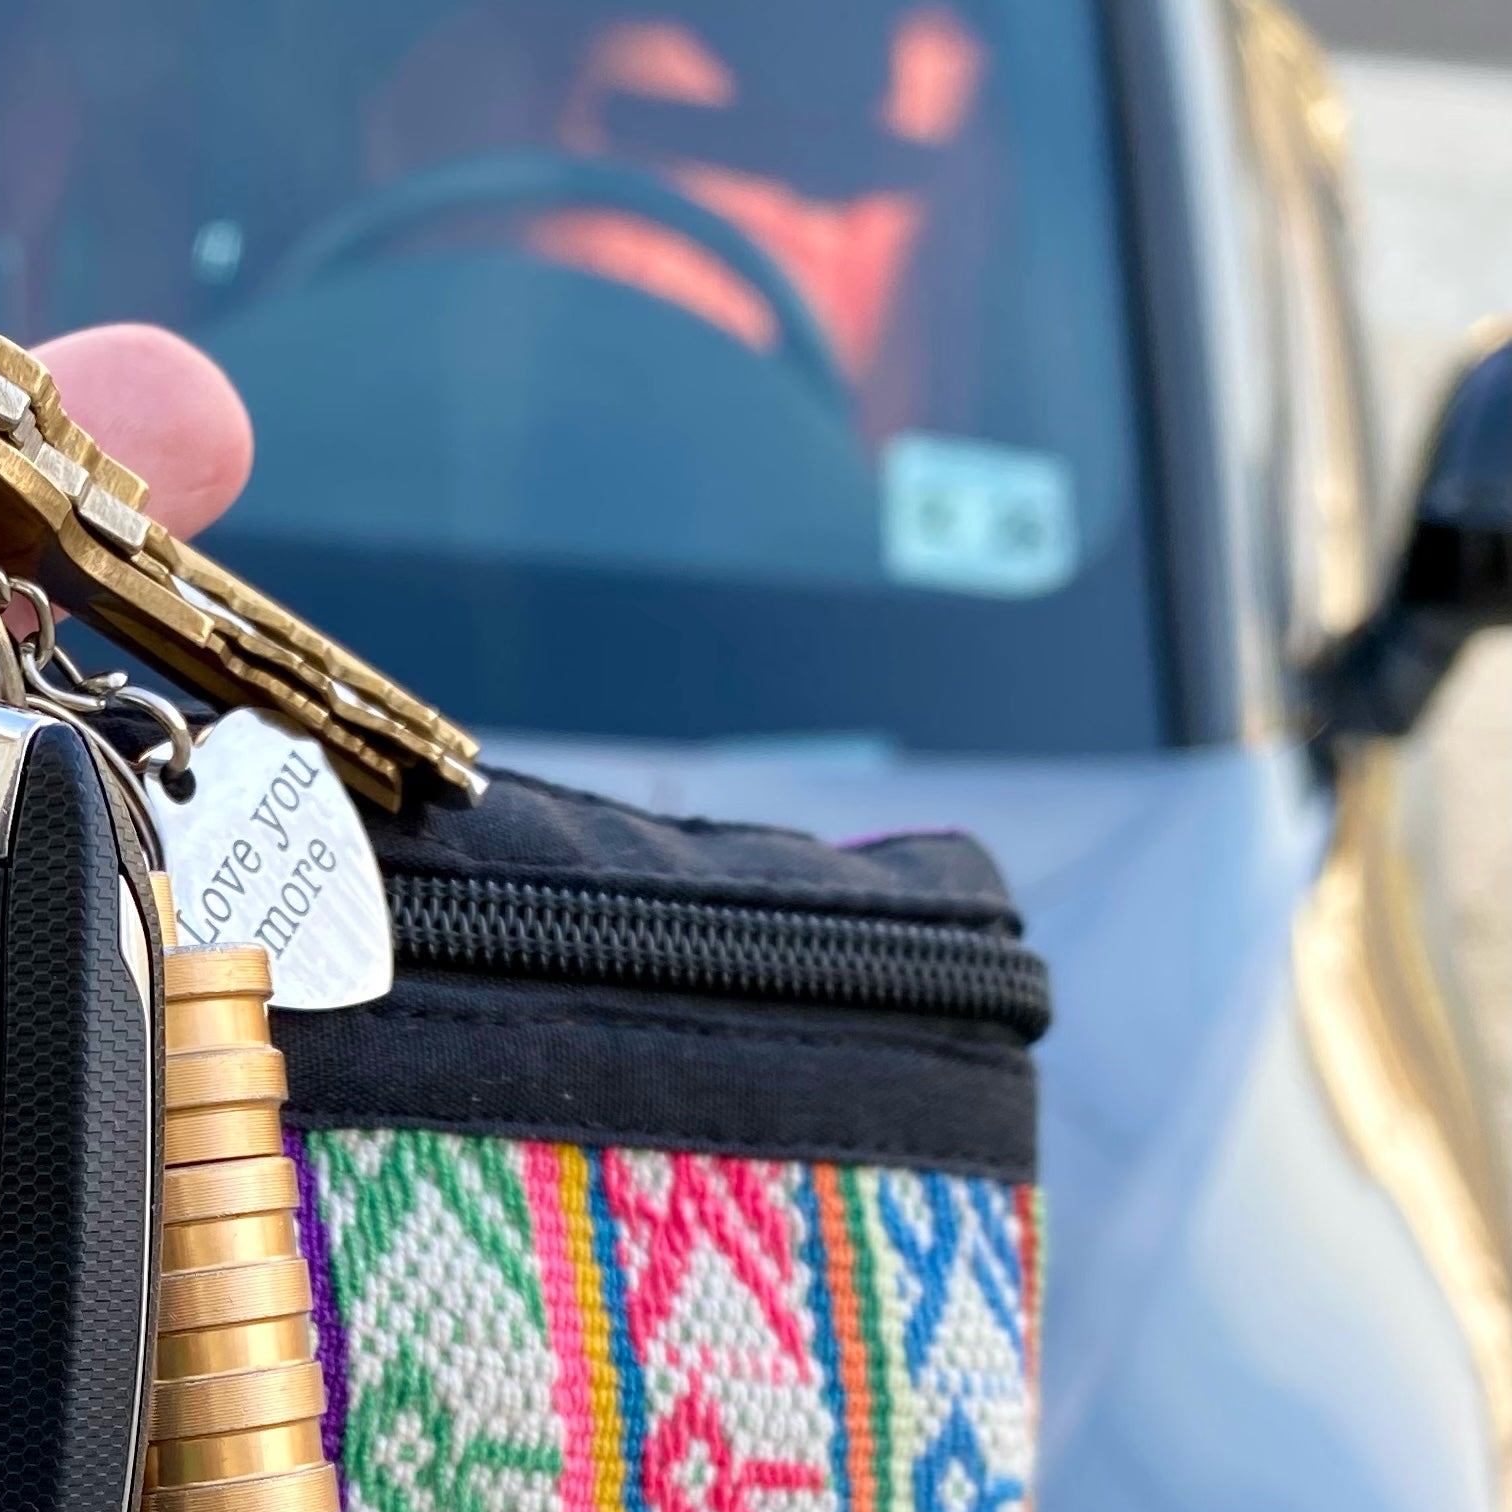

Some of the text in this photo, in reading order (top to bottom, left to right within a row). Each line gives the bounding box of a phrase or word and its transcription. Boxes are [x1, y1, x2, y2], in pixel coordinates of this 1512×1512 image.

[176, 750, 319, 945] Love you
[254, 839, 336, 960] more
